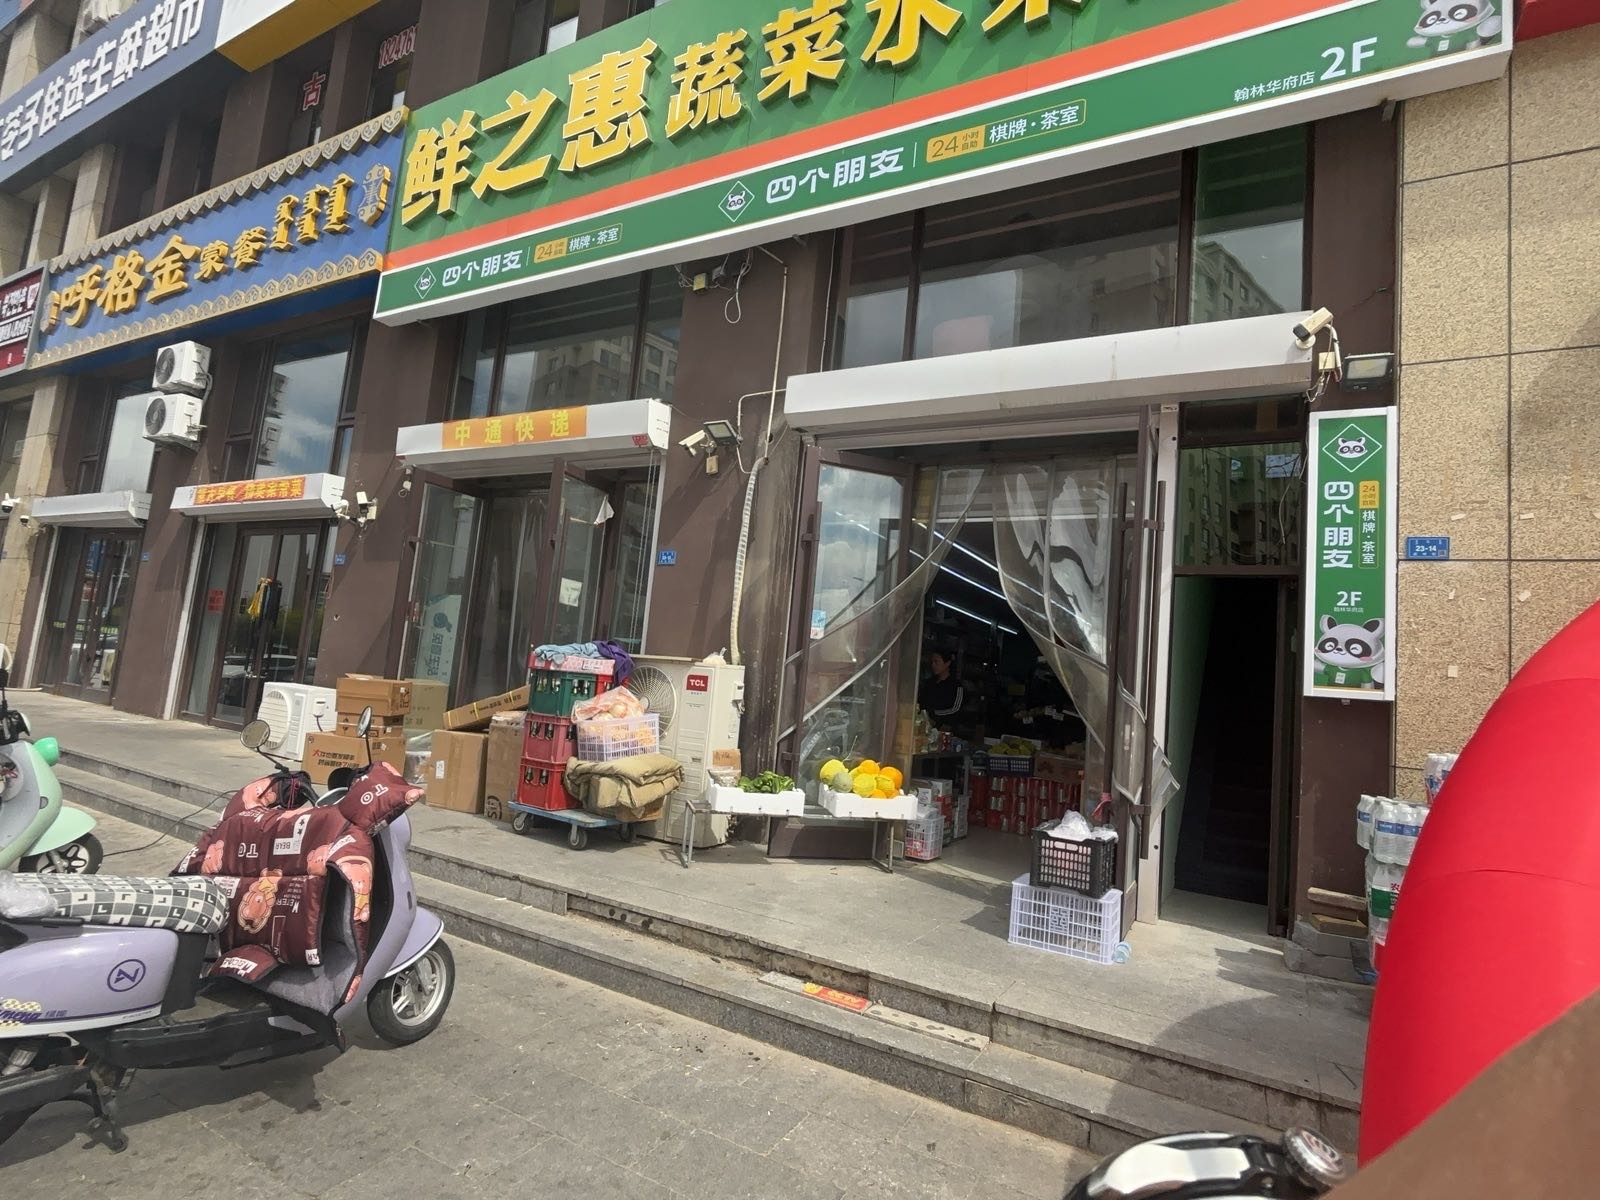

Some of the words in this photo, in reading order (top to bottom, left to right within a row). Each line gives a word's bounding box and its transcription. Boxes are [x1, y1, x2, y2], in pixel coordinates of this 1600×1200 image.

[1320, 37, 1378, 81] 2F
[1234, 71, 1315, 102] 翰林华府店
[402, 0, 1082, 226] 鲜之惠蔬菜水
[766, 147, 904, 204] 四个朋友
[932, 136, 959, 158] 24
[962, 129, 980, 143] 小时
[989, 105, 1080, 144] 棋牌·茶室
[442, 250, 523, 287] 四个朋友
[536, 244, 553, 260] 24
[568, 227, 619, 252] 棋牌·茶室
[455, 410, 570, 446] 中通快递
[1362, 485, 1376, 493] 24
[1323, 481, 1355, 568] 四个朋友
[1336, 591, 1362, 606] 2F
[689, 679, 705, 687] TCL
